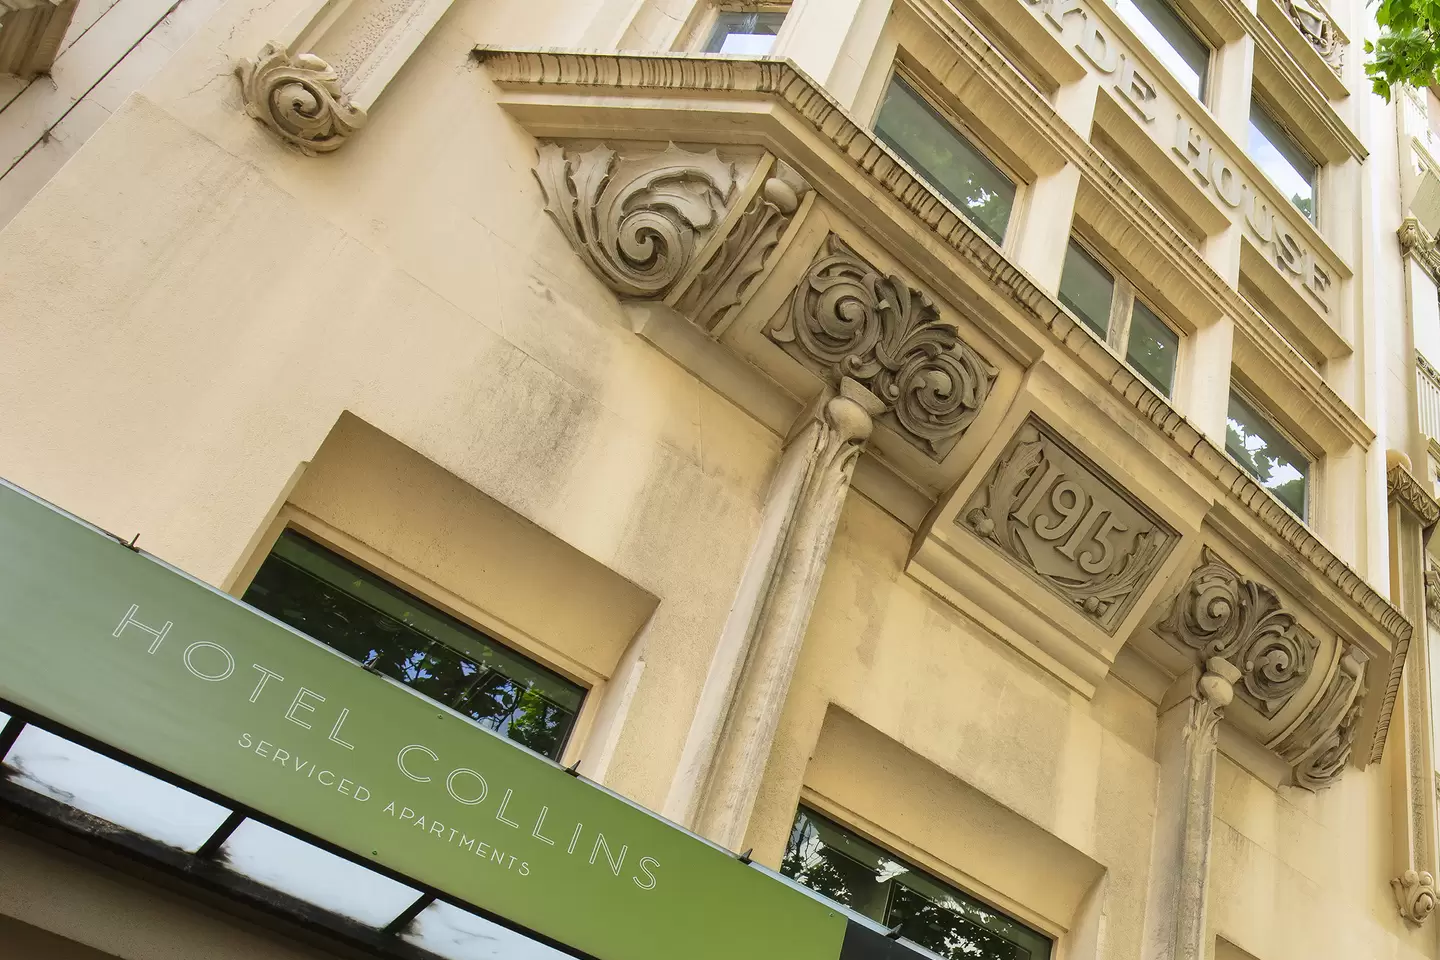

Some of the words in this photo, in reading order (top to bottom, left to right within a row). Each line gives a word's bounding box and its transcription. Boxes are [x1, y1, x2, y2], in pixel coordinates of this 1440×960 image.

[1171, 113, 1334, 315] HOUSE
[1009, 458, 1129, 574] 1915
[112, 603, 355, 751] HOTEL
[397, 743, 662, 891] COLLINS
[237, 731, 371, 803] SERVICED
[382, 800, 531, 877] APARTMENTS
